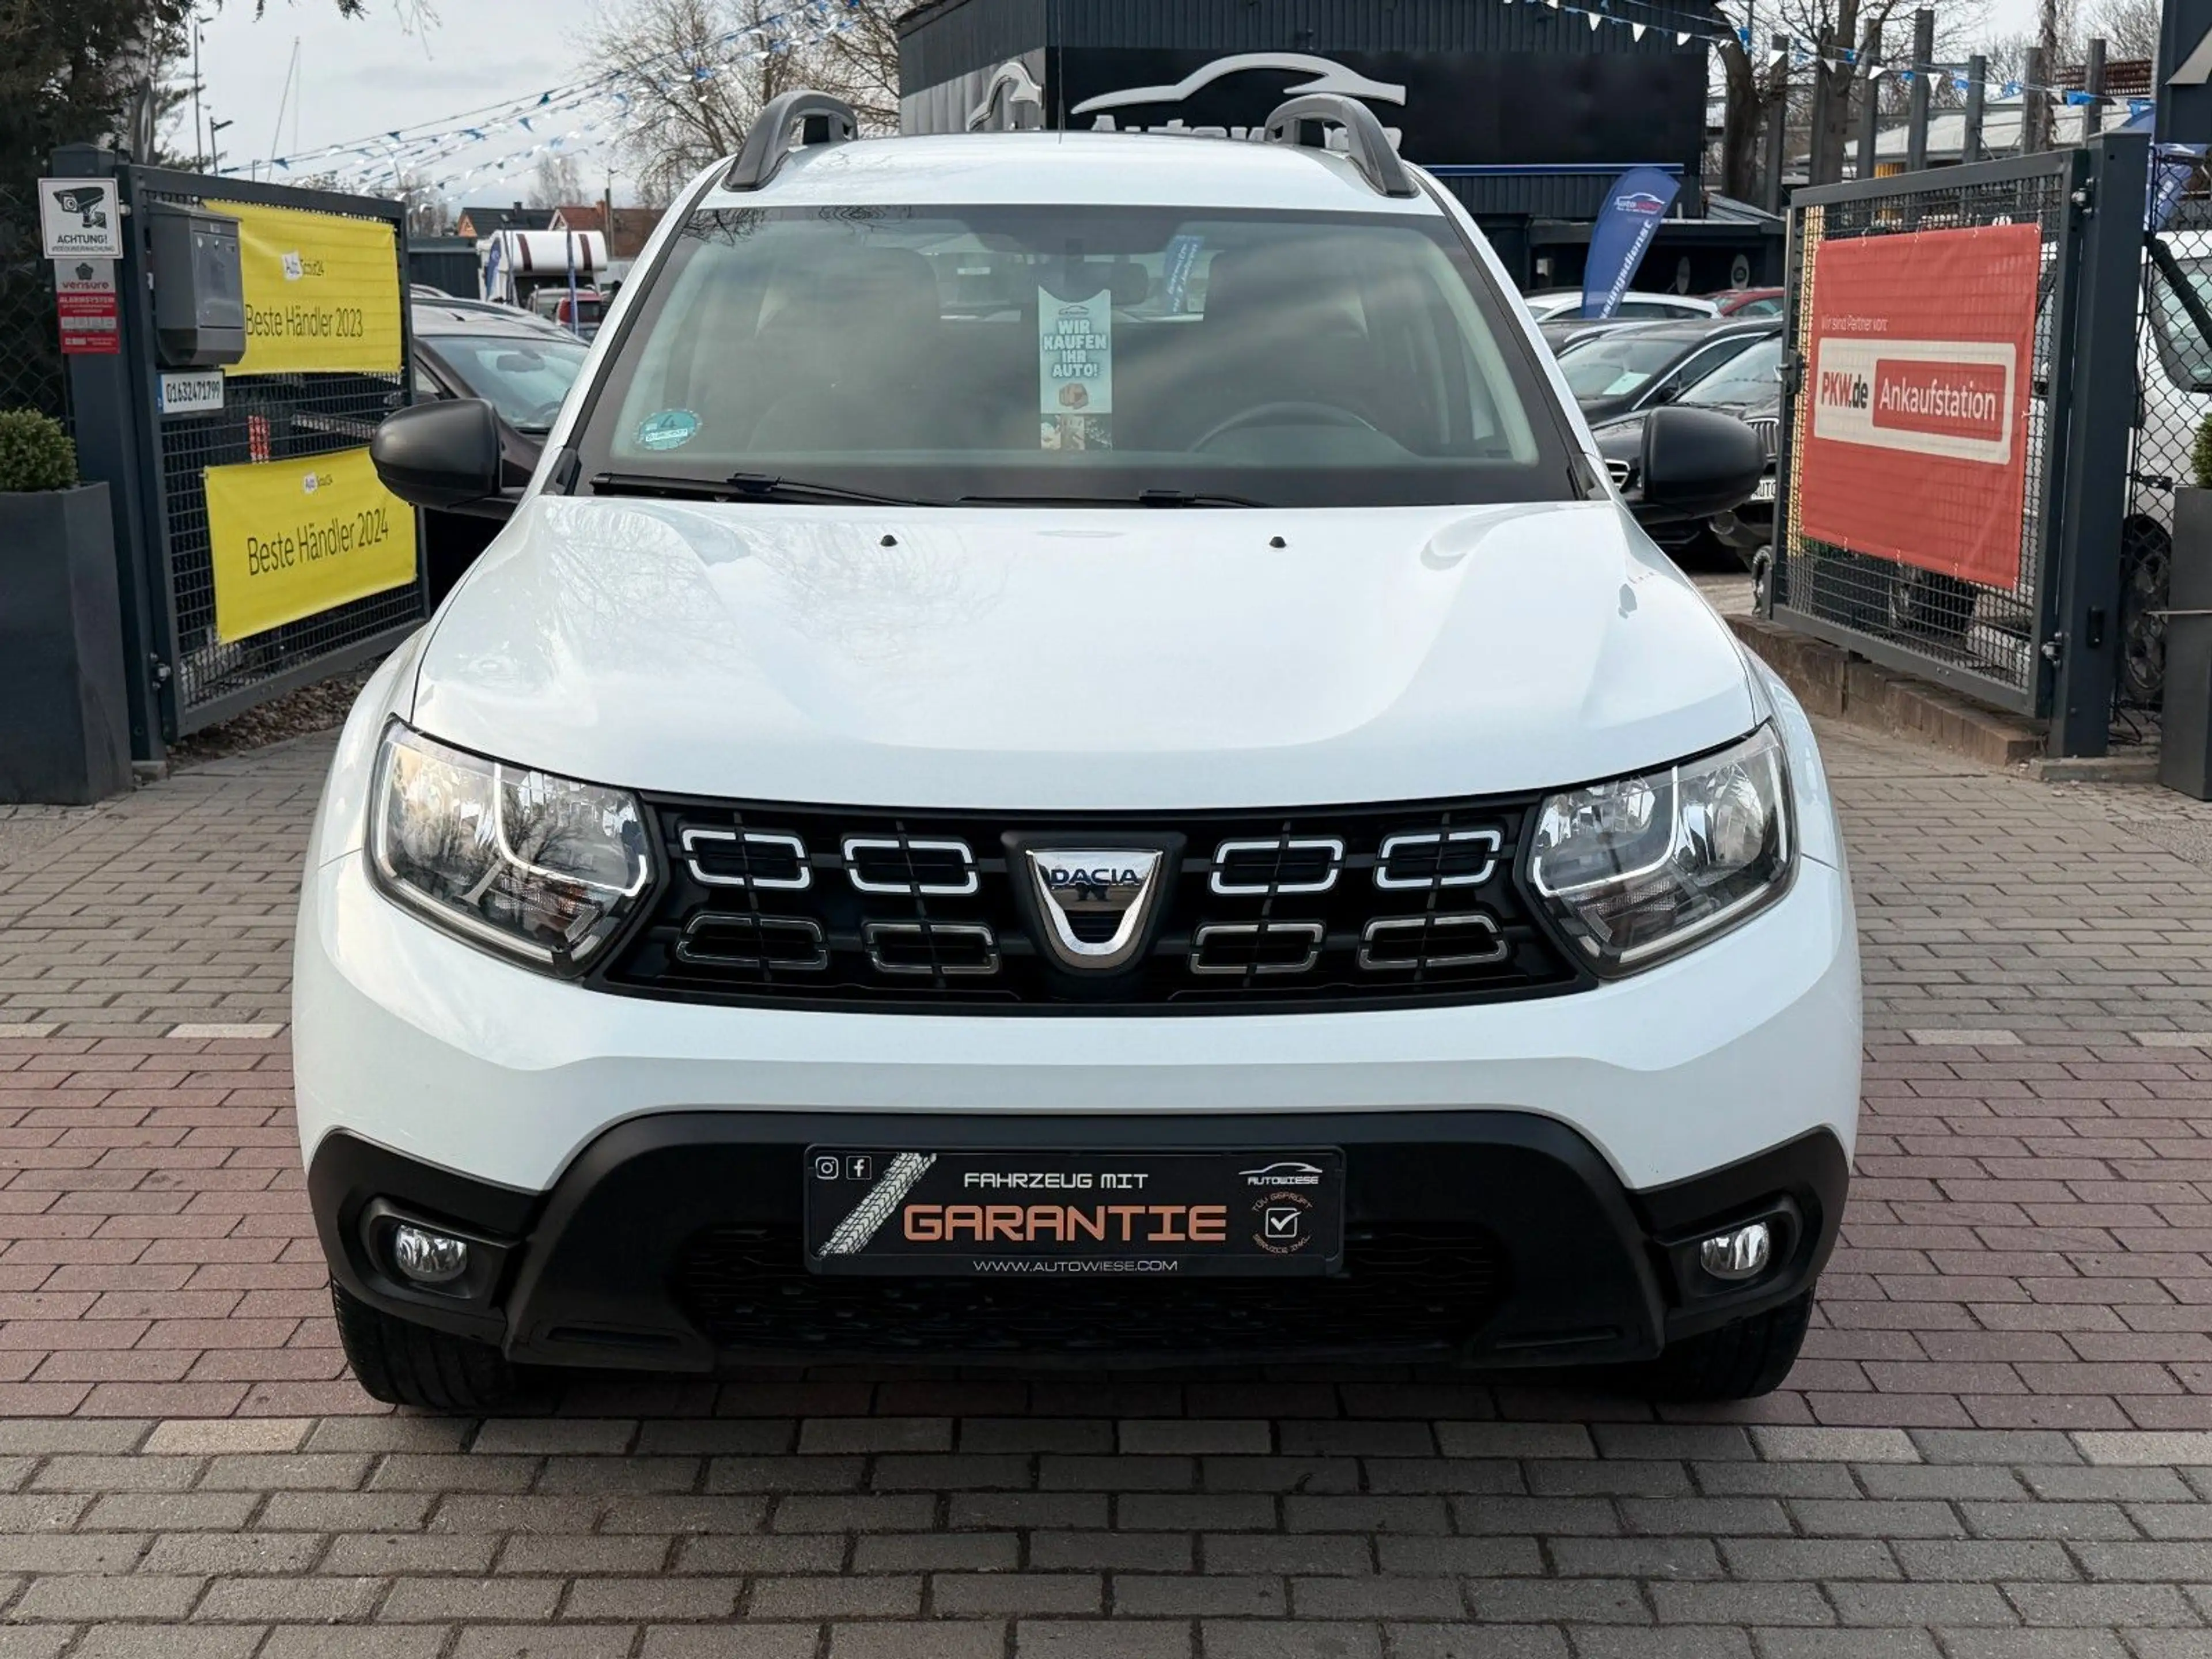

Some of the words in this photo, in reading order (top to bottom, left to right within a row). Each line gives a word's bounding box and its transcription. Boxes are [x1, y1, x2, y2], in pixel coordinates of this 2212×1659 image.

[57, 234, 108, 244] ACHTUNG!
[62, 281, 110, 289] verisure
[245, 304, 283, 336] Beste
[286, 305, 333, 337] Händler
[335, 307, 363, 338] 2023
[1057, 319, 1091, 334] WIR
[1062, 349, 1087, 363] IHR
[1052, 363, 1098, 377] AUTO!
[166, 380, 221, 403] 01632471799
[1821, 372, 1869, 410] PKW.de
[1879, 376, 1997, 421] Ankaufstation
[660, 415, 677, 428] 4
[247, 531, 294, 576] Beste
[297, 518, 355, 564] Händler
[358, 507, 389, 548] 2024
[1050, 869, 1140, 885] DACIA
[964, 1173, 1092, 1189] FAHRZEUG
[1101, 1173, 1149, 1189] MIT
[1247, 1176, 1319, 1185] AUTOWIESE
[903, 1205, 1227, 1241] GARANTIE
[973, 1260, 1177, 1272] WWW.AUTOWIESE.COM
